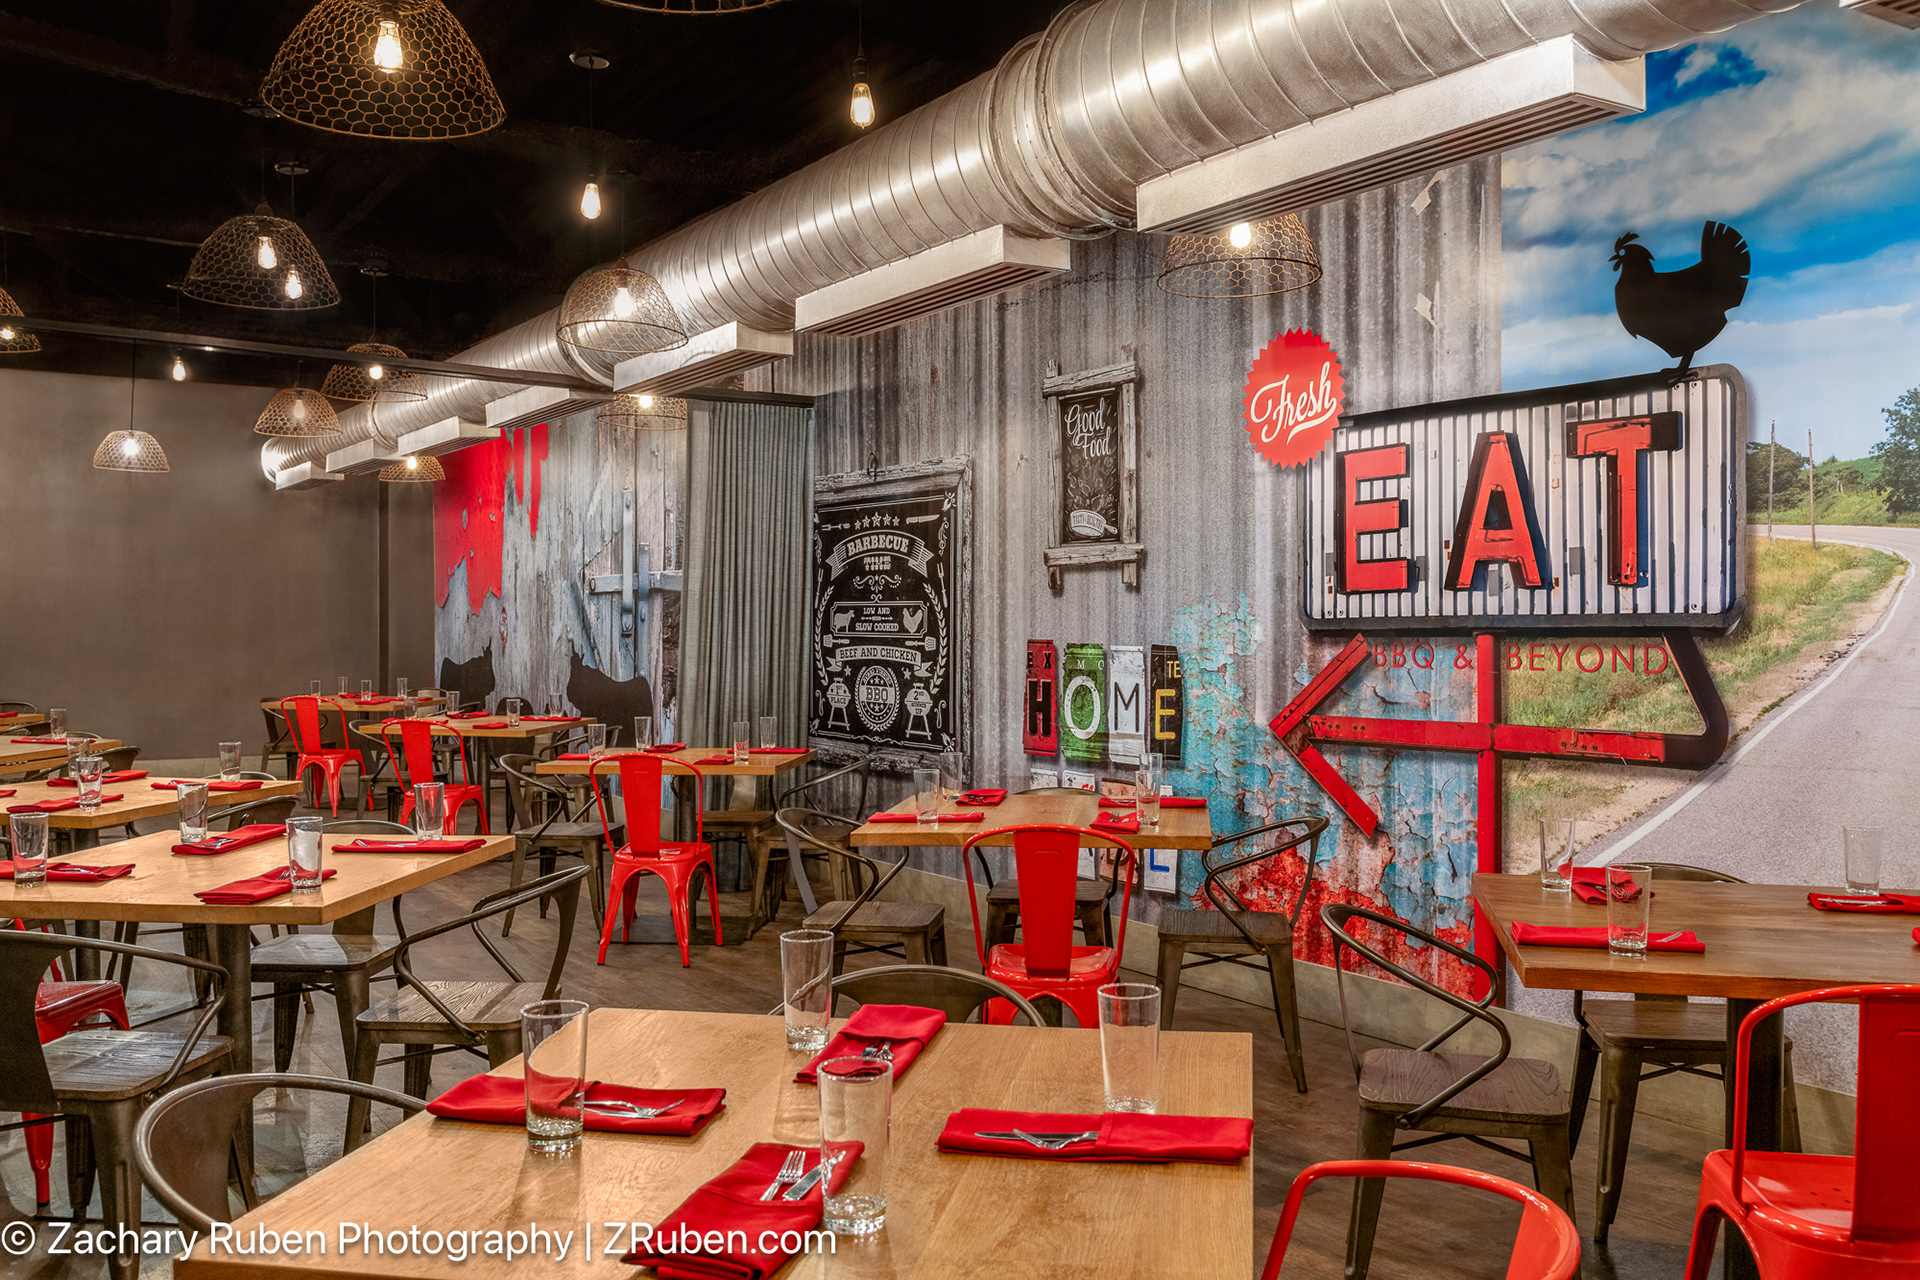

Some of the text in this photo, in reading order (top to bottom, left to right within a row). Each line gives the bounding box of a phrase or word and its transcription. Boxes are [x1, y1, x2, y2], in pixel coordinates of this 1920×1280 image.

[1250, 360, 1337, 446] Fresh
[1064, 397, 1106, 446] Good
[1075, 426, 1112, 460] Food
[1337, 411, 1683, 595] EAT
[847, 534, 909, 557] BARBECUE
[863, 555, 892, 572] TIME
[863, 607, 891, 615] LOW AND
[855, 622, 899, 632] SLOW COOKED
[840, 647, 918, 662] BEEF AND CHICKEN
[1373, 642, 1669, 674] BBQ & BEYOND
[830, 696, 847, 705] PLACE
[865, 686, 889, 702] BBQ
[1027, 675, 1176, 741] HOME
